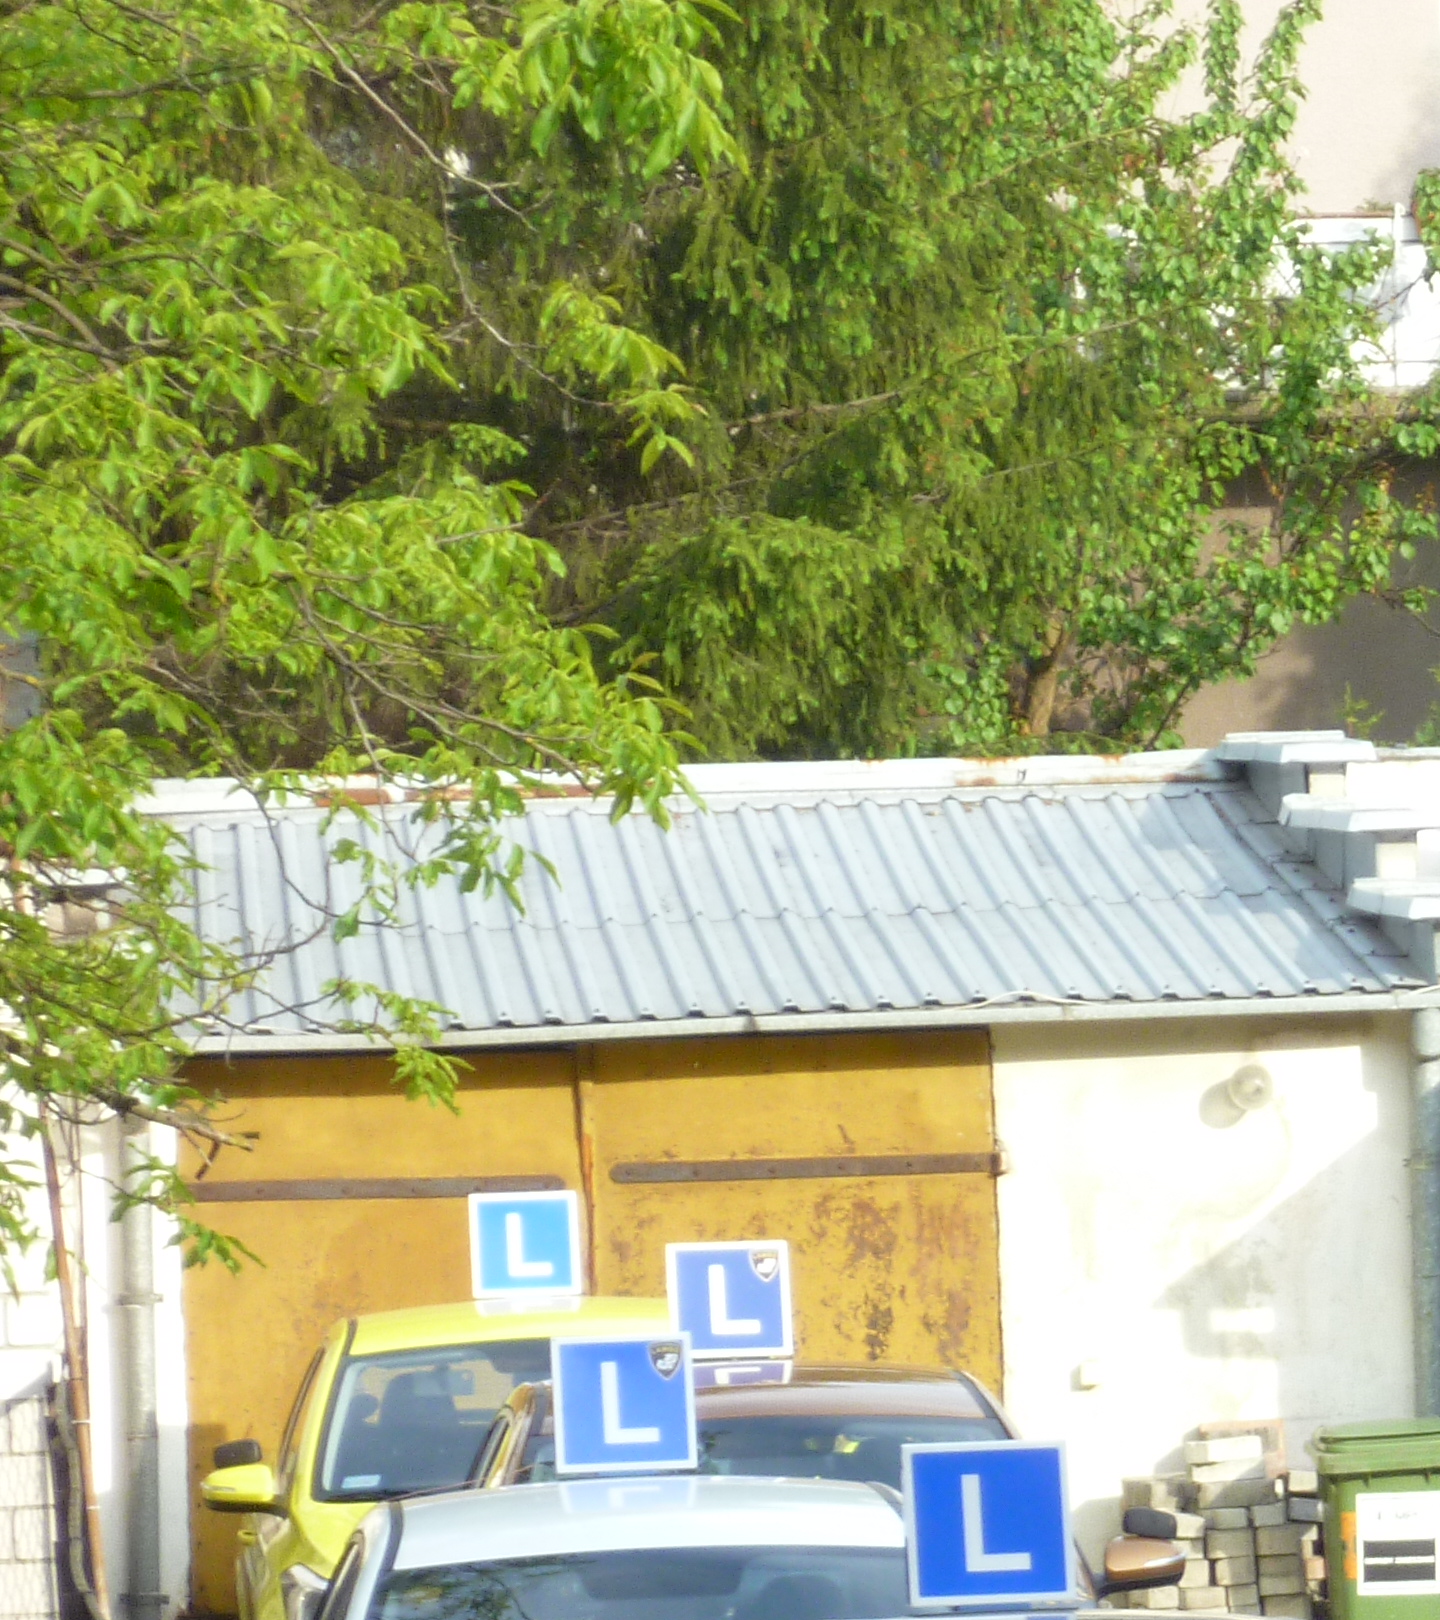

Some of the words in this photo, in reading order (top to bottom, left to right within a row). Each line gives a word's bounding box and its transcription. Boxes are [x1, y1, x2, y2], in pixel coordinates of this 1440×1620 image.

[505, 1212, 554, 1276] L
[708, 1264, 761, 1335] L
[601, 1361, 660, 1445] L
[961, 1474, 1031, 1573] L
